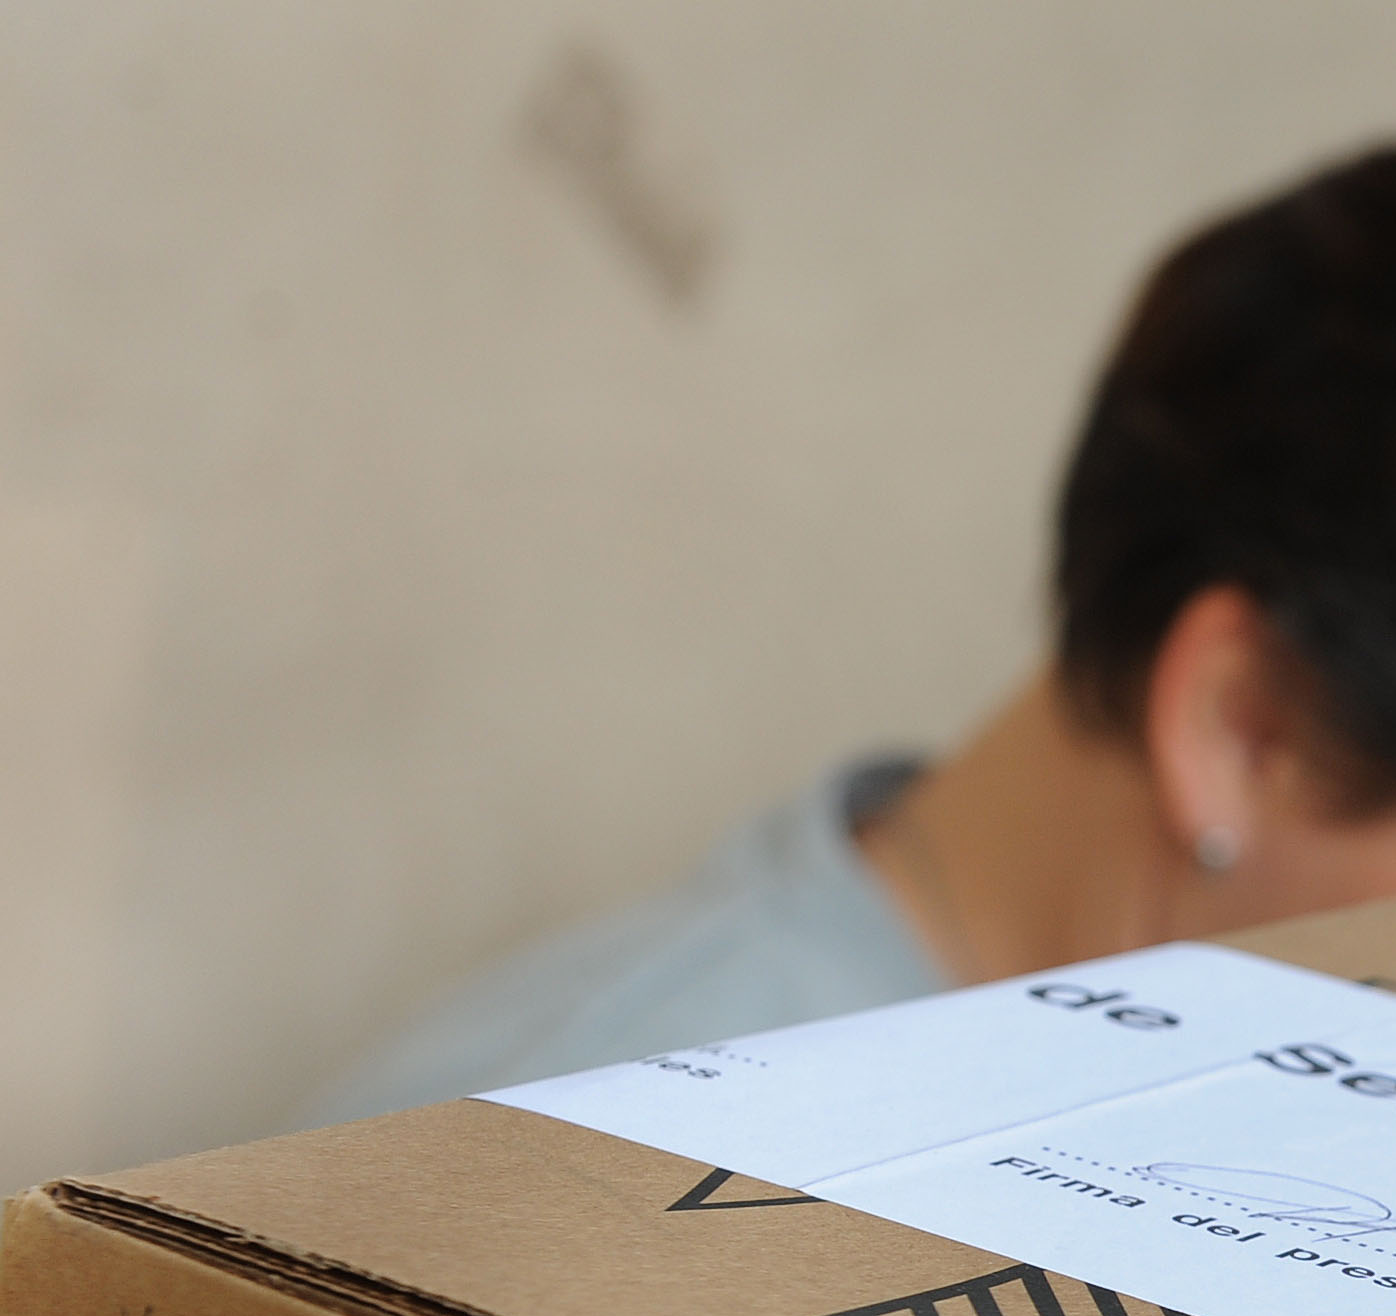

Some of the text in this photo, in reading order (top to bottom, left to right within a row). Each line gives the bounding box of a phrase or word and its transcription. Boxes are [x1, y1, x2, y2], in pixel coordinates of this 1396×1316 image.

[1027, 982, 1182, 1032] de
[989, 1156, 1147, 1208] Firma
[1170, 1212, 1267, 1243] del
